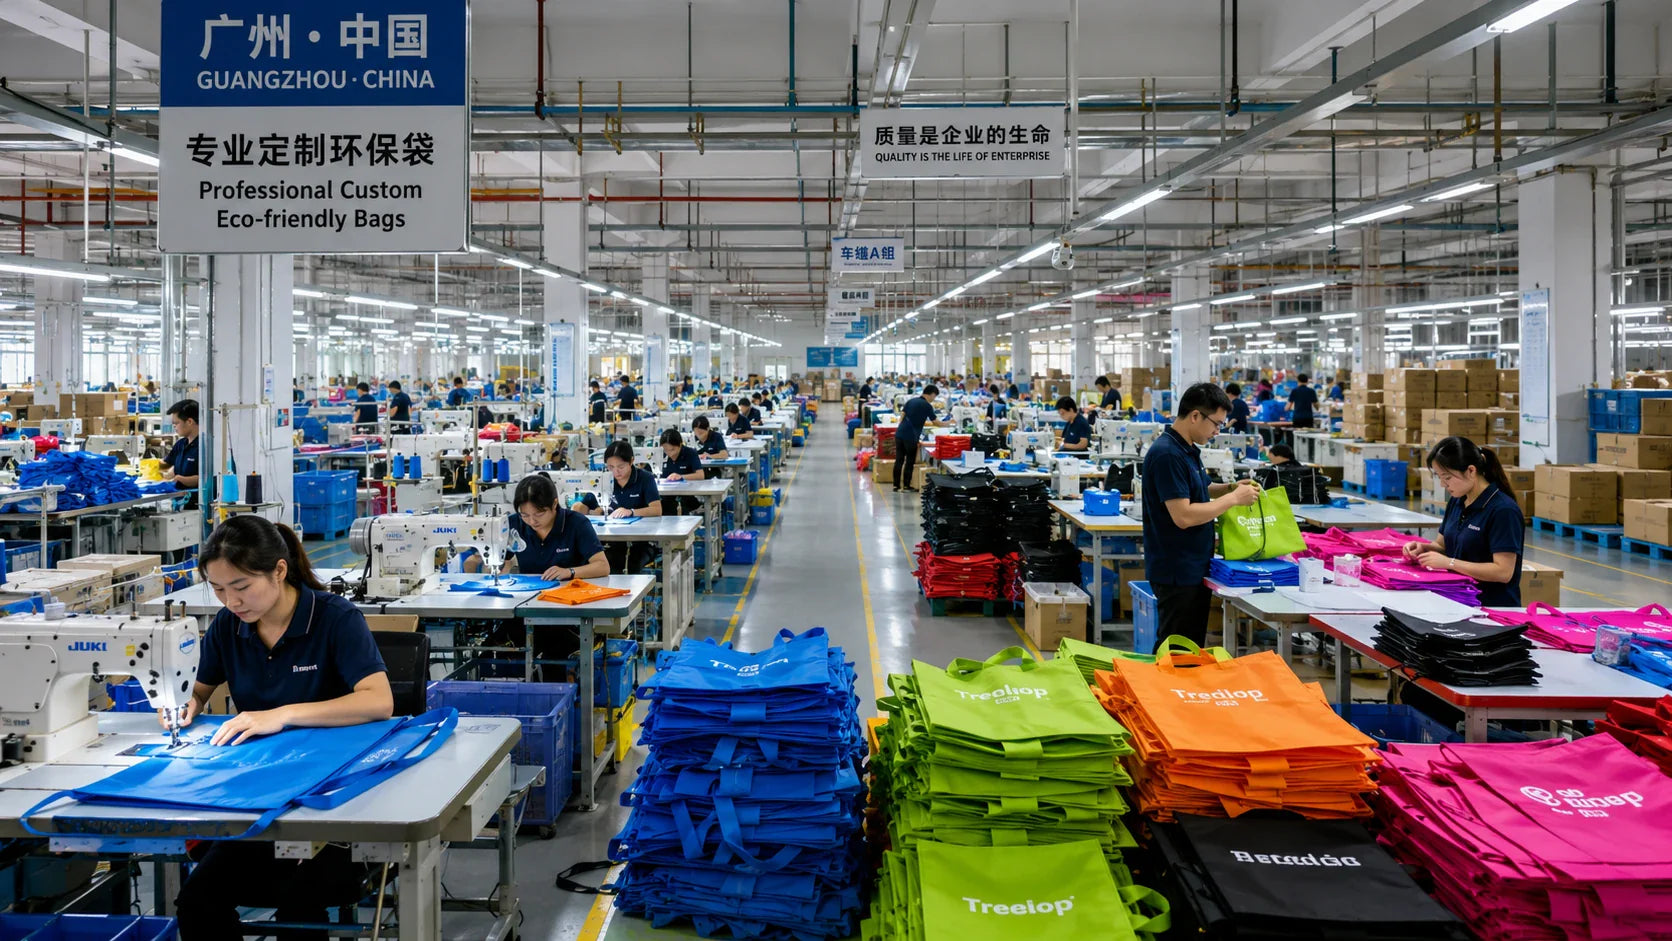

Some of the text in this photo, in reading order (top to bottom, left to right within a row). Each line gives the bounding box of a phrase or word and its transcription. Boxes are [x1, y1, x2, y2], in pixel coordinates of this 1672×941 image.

[874, 124, 1051, 146] 质量是企业的生命
[186, 132, 434, 167] 专业定制环保袋
[875, 151, 1050, 163] QUALITY IS THE LIFE OF ENTERPRISE
[199, 179, 422, 200] Professional Custom
[217, 208, 406, 233] Eco-friendly Bags
[67, 641, 107, 652] JUKI
